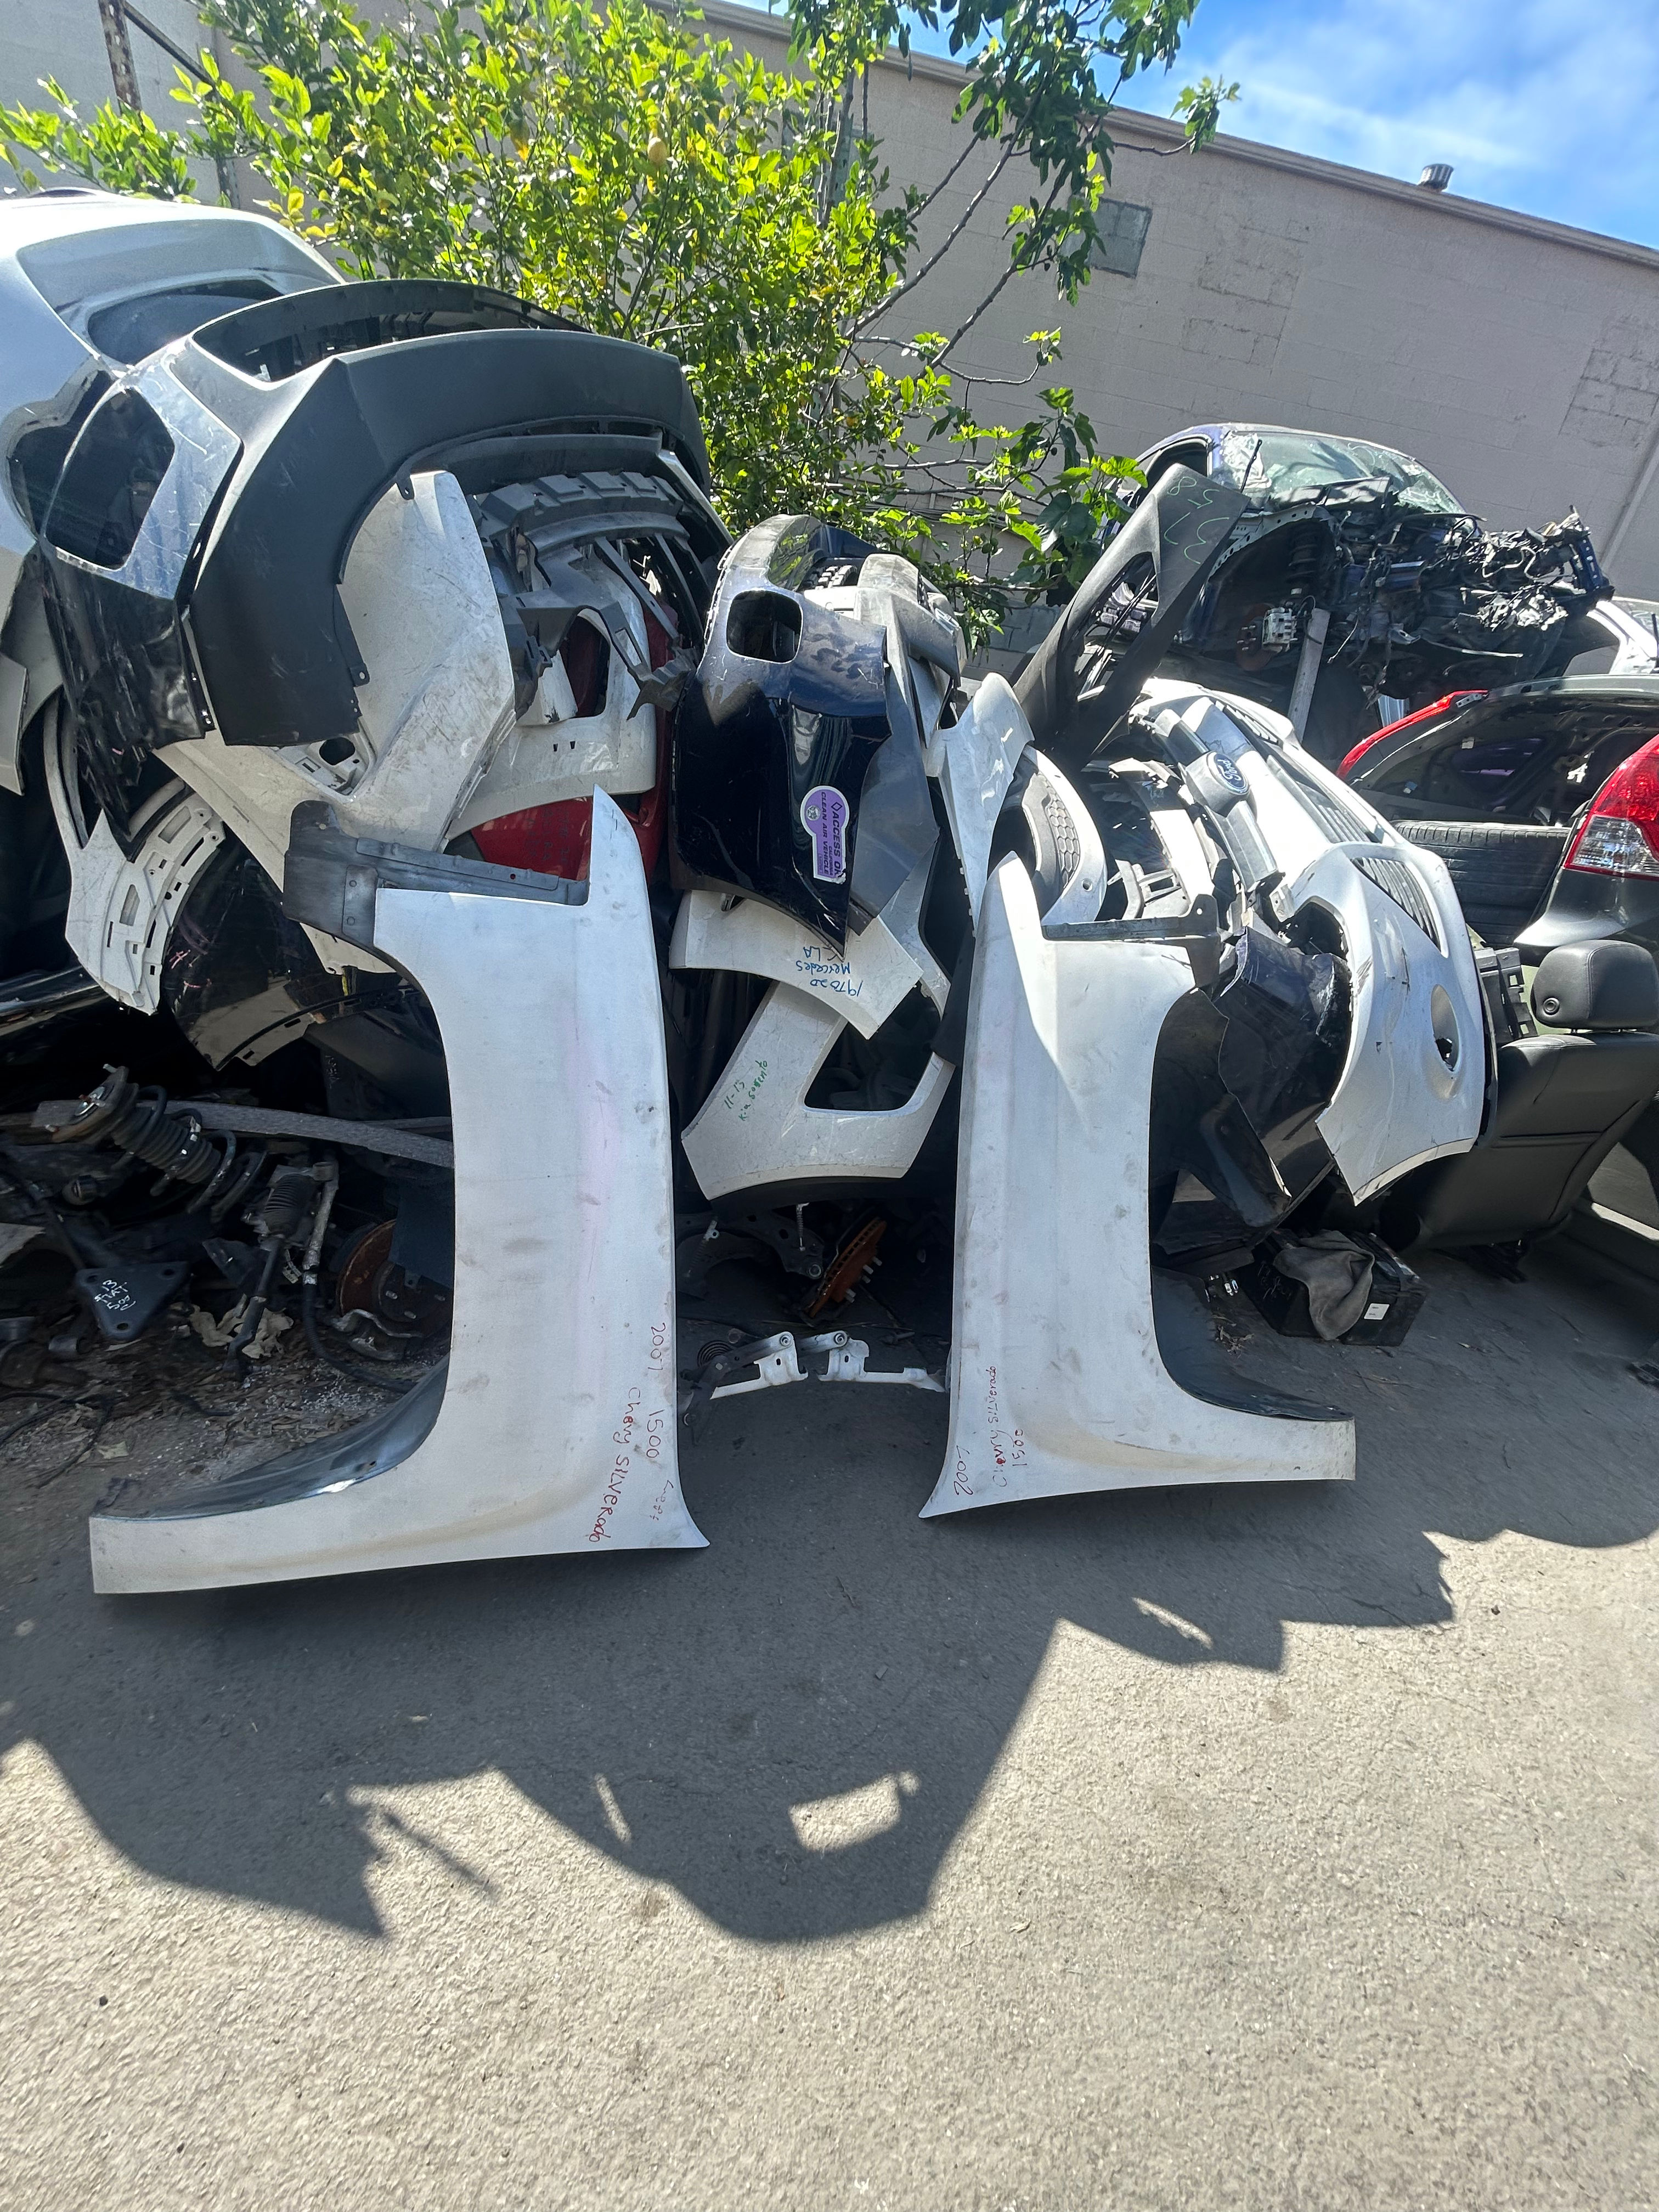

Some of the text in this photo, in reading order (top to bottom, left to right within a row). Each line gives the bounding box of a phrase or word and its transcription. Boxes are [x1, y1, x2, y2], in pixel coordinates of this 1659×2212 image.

[1217, 759, 1242, 781] Ford
[832, 811, 841, 877] ACCESS OK
[795, 960, 851, 976] Mercedes
[646, 1409, 664, 1459] 1500
[953, 1444, 974, 1496] 2007
